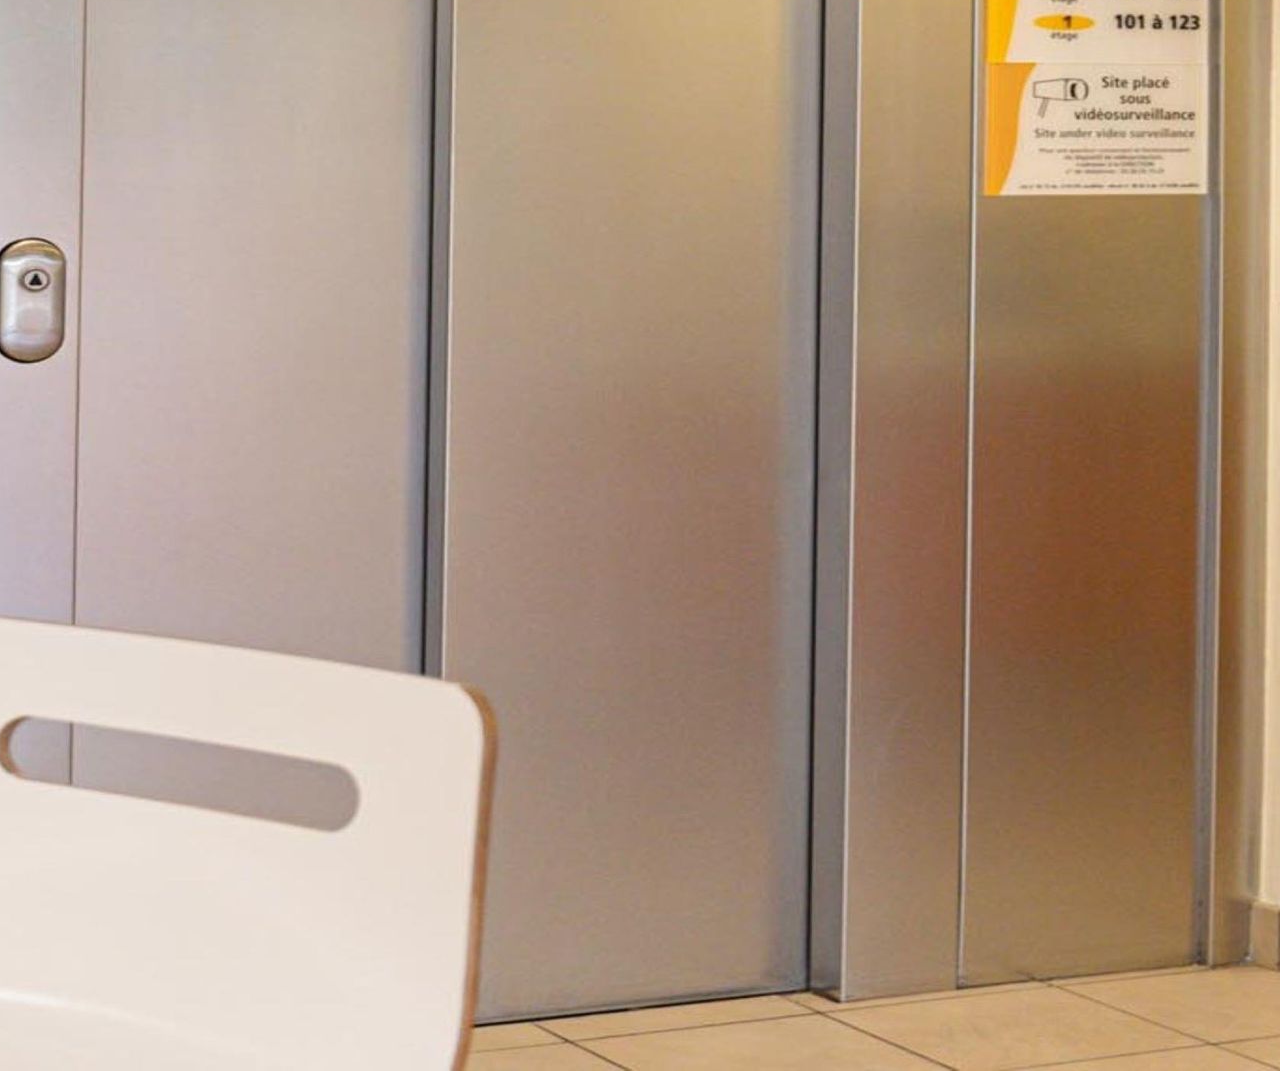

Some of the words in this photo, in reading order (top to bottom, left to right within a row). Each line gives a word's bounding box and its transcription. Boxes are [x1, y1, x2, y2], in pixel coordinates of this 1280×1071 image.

[1063, 15, 1072, 29] 1
[1115, 14, 1145, 29] 101
[1152, 14, 1163, 29] à
[1169, 15, 1201, 30] 123
[1101, 76, 1129, 88] Site
[1132, 76, 1170, 90] placé
[1119, 95, 1151, 104] sous
[1074, 108, 1196, 121] vidéosurveillance
[1033, 128, 1057, 138] Site
[1058, 128, 1093, 138] under
[1129, 128, 1196, 138] surveillance
